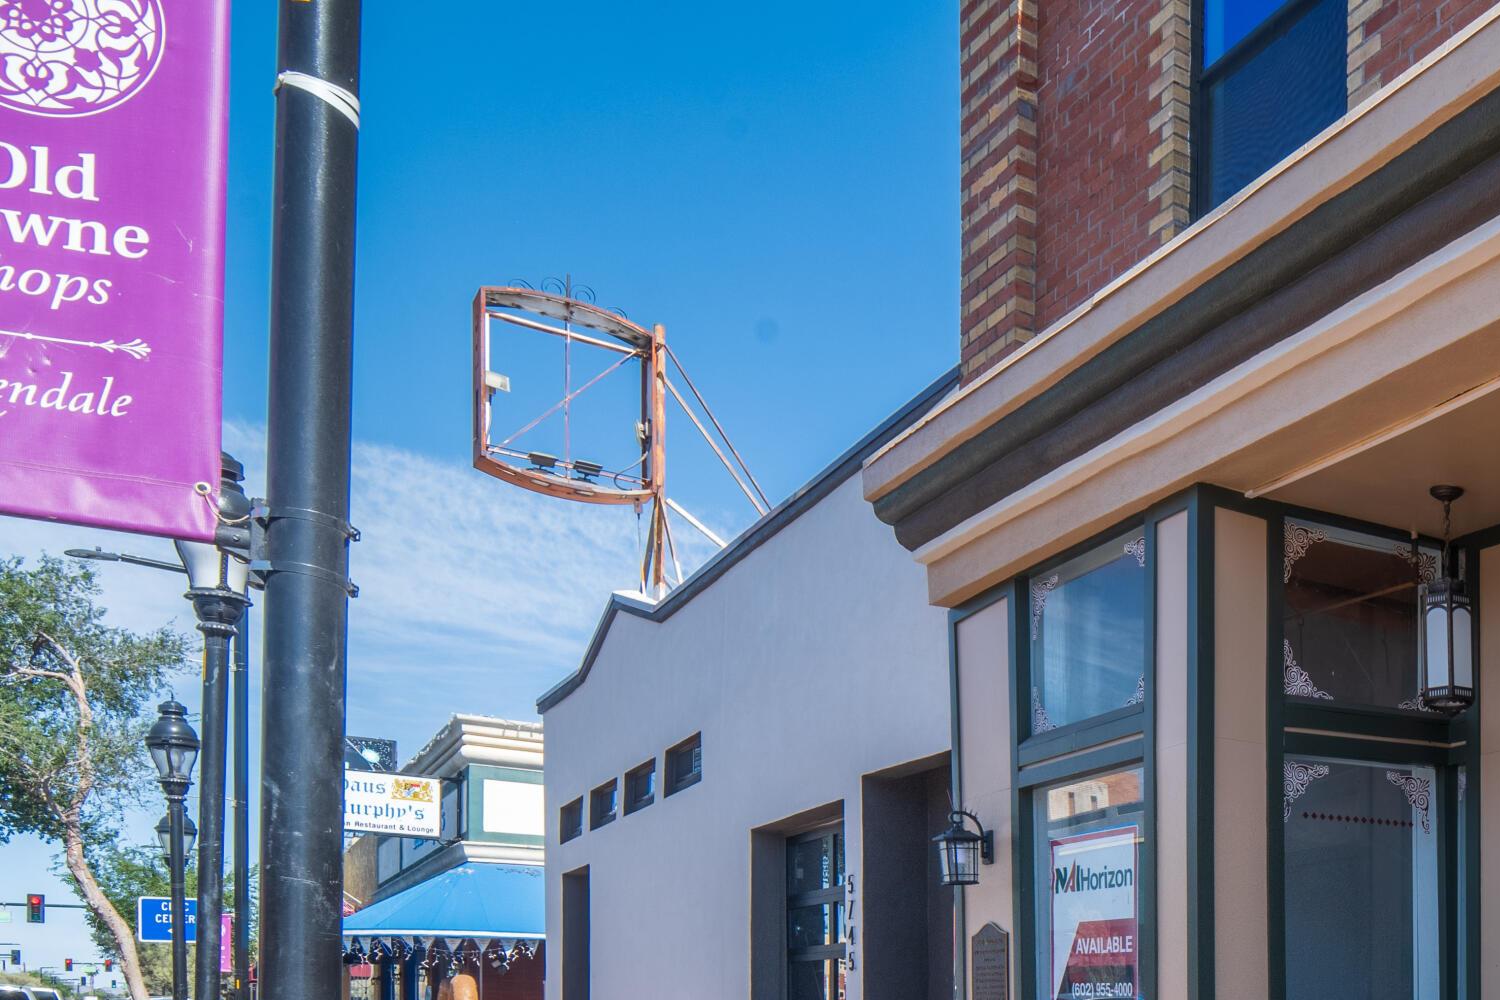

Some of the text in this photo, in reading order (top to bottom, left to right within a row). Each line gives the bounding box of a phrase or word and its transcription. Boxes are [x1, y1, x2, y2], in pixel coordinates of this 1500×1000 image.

[0, 208, 150, 259] wne
[344, 778, 386, 794] aus
[345, 803, 424, 820] urphy's
[354, 821, 396, 831] Restaurant
[407, 825, 434, 834] Lounge
[1075, 936, 1133, 955] AVAILABLE
[1072, 982, 1133, 999] (602) 955-4000
